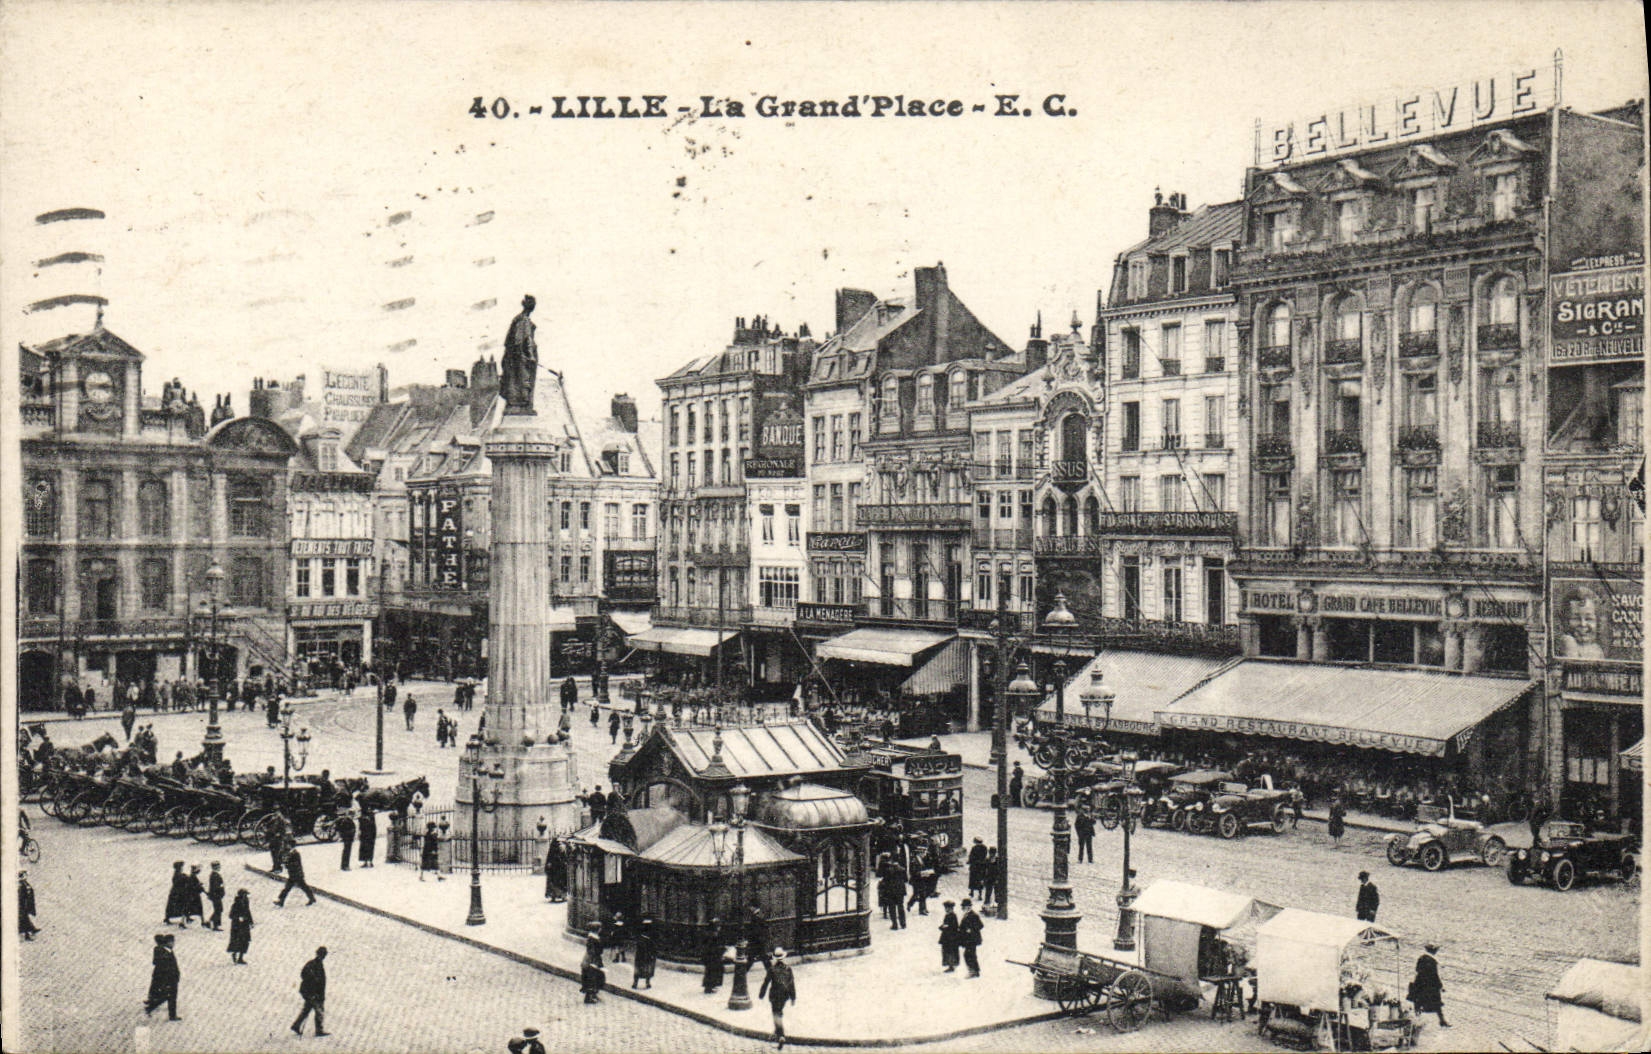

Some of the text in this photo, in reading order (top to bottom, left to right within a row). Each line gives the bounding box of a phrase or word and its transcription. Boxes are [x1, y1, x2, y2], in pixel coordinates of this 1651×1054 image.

[1273, 70, 1537, 162] BELLEVUE
[762, 424, 802, 446] BANQUE
[806, 608, 814, 619] LA
[1323, 596, 1356, 612] GRAND
[1170, 716, 1425, 750] GRAND RESTAURANT BELLEVUE
